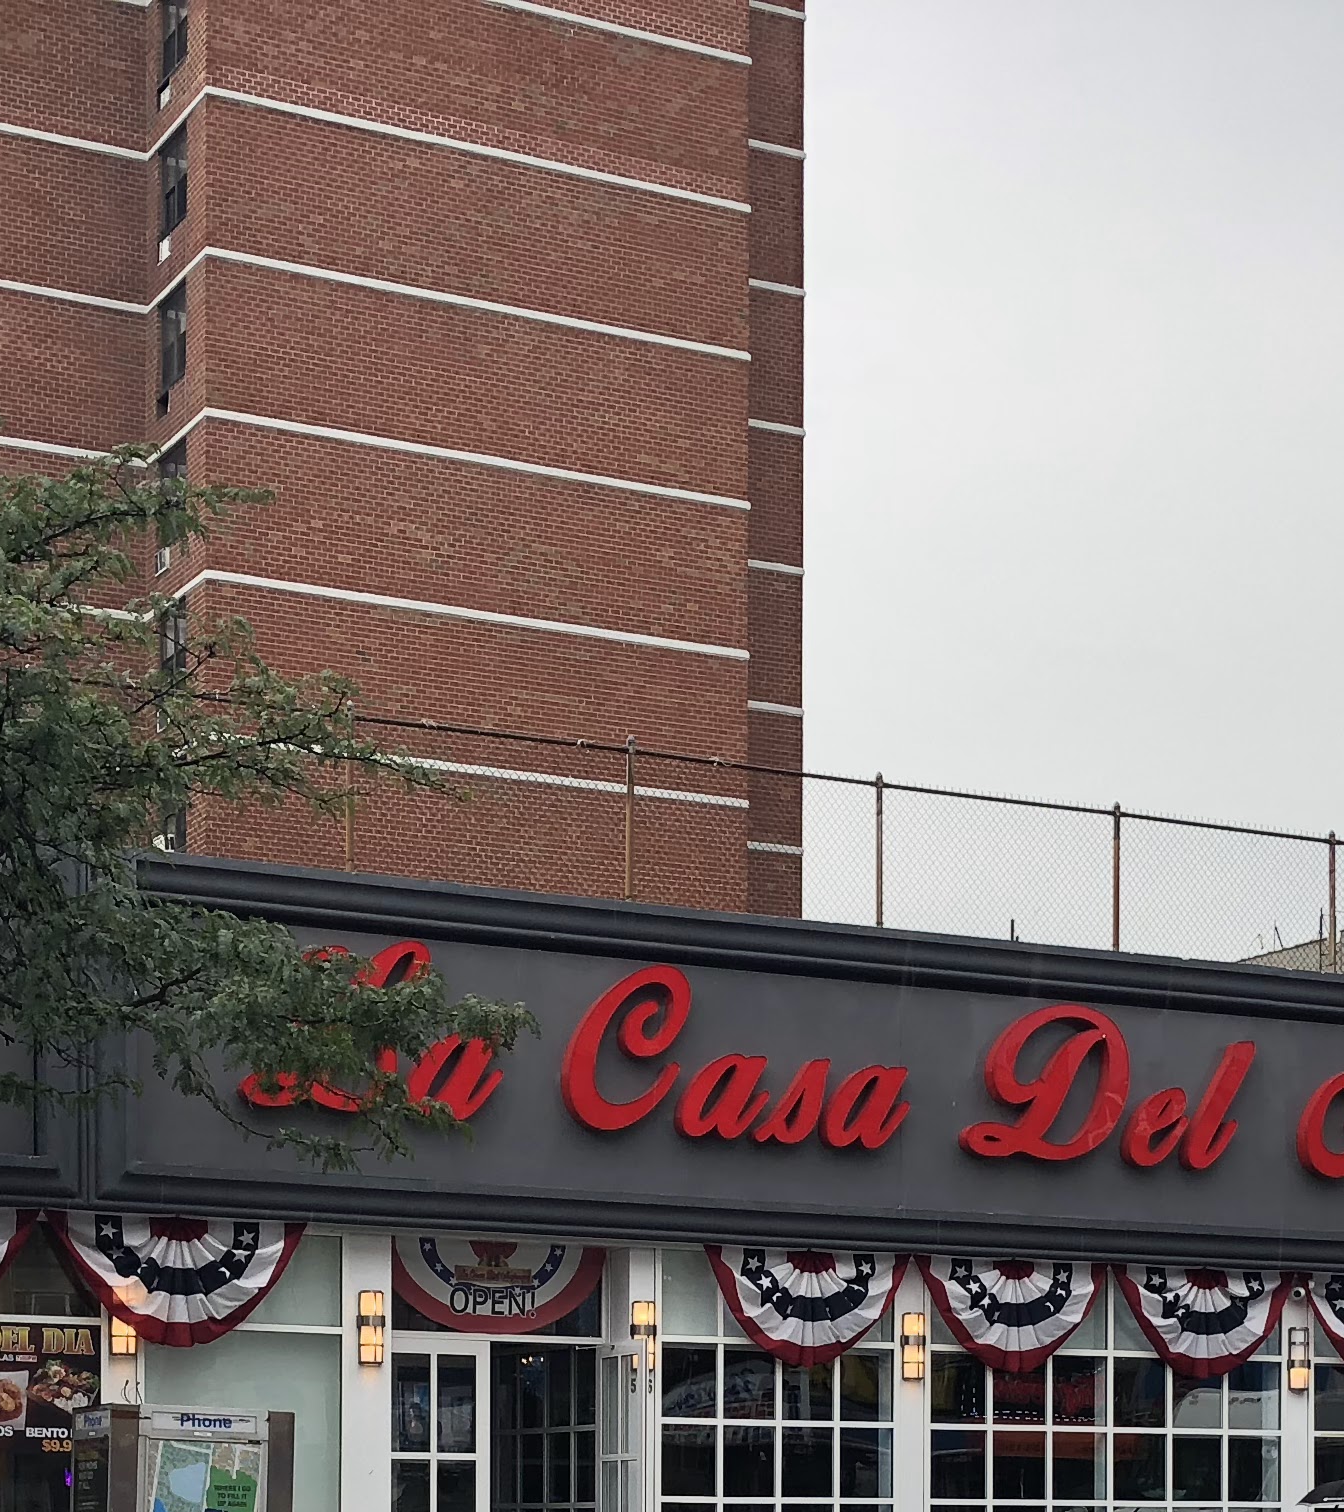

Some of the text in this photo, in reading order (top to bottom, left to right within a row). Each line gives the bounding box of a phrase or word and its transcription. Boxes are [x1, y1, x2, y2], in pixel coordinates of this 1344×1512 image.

[561, 962, 910, 1150] Casa
[958, 1003, 1255, 1171] Del
[449, 1286, 536, 1319] OPEN!
[41, 1327, 96, 1356] DIA
[25, 1426, 67, 1439] BENTO
[179, 1413, 233, 1430] Phone
[41, 1438, 73, 1453] $9.9
